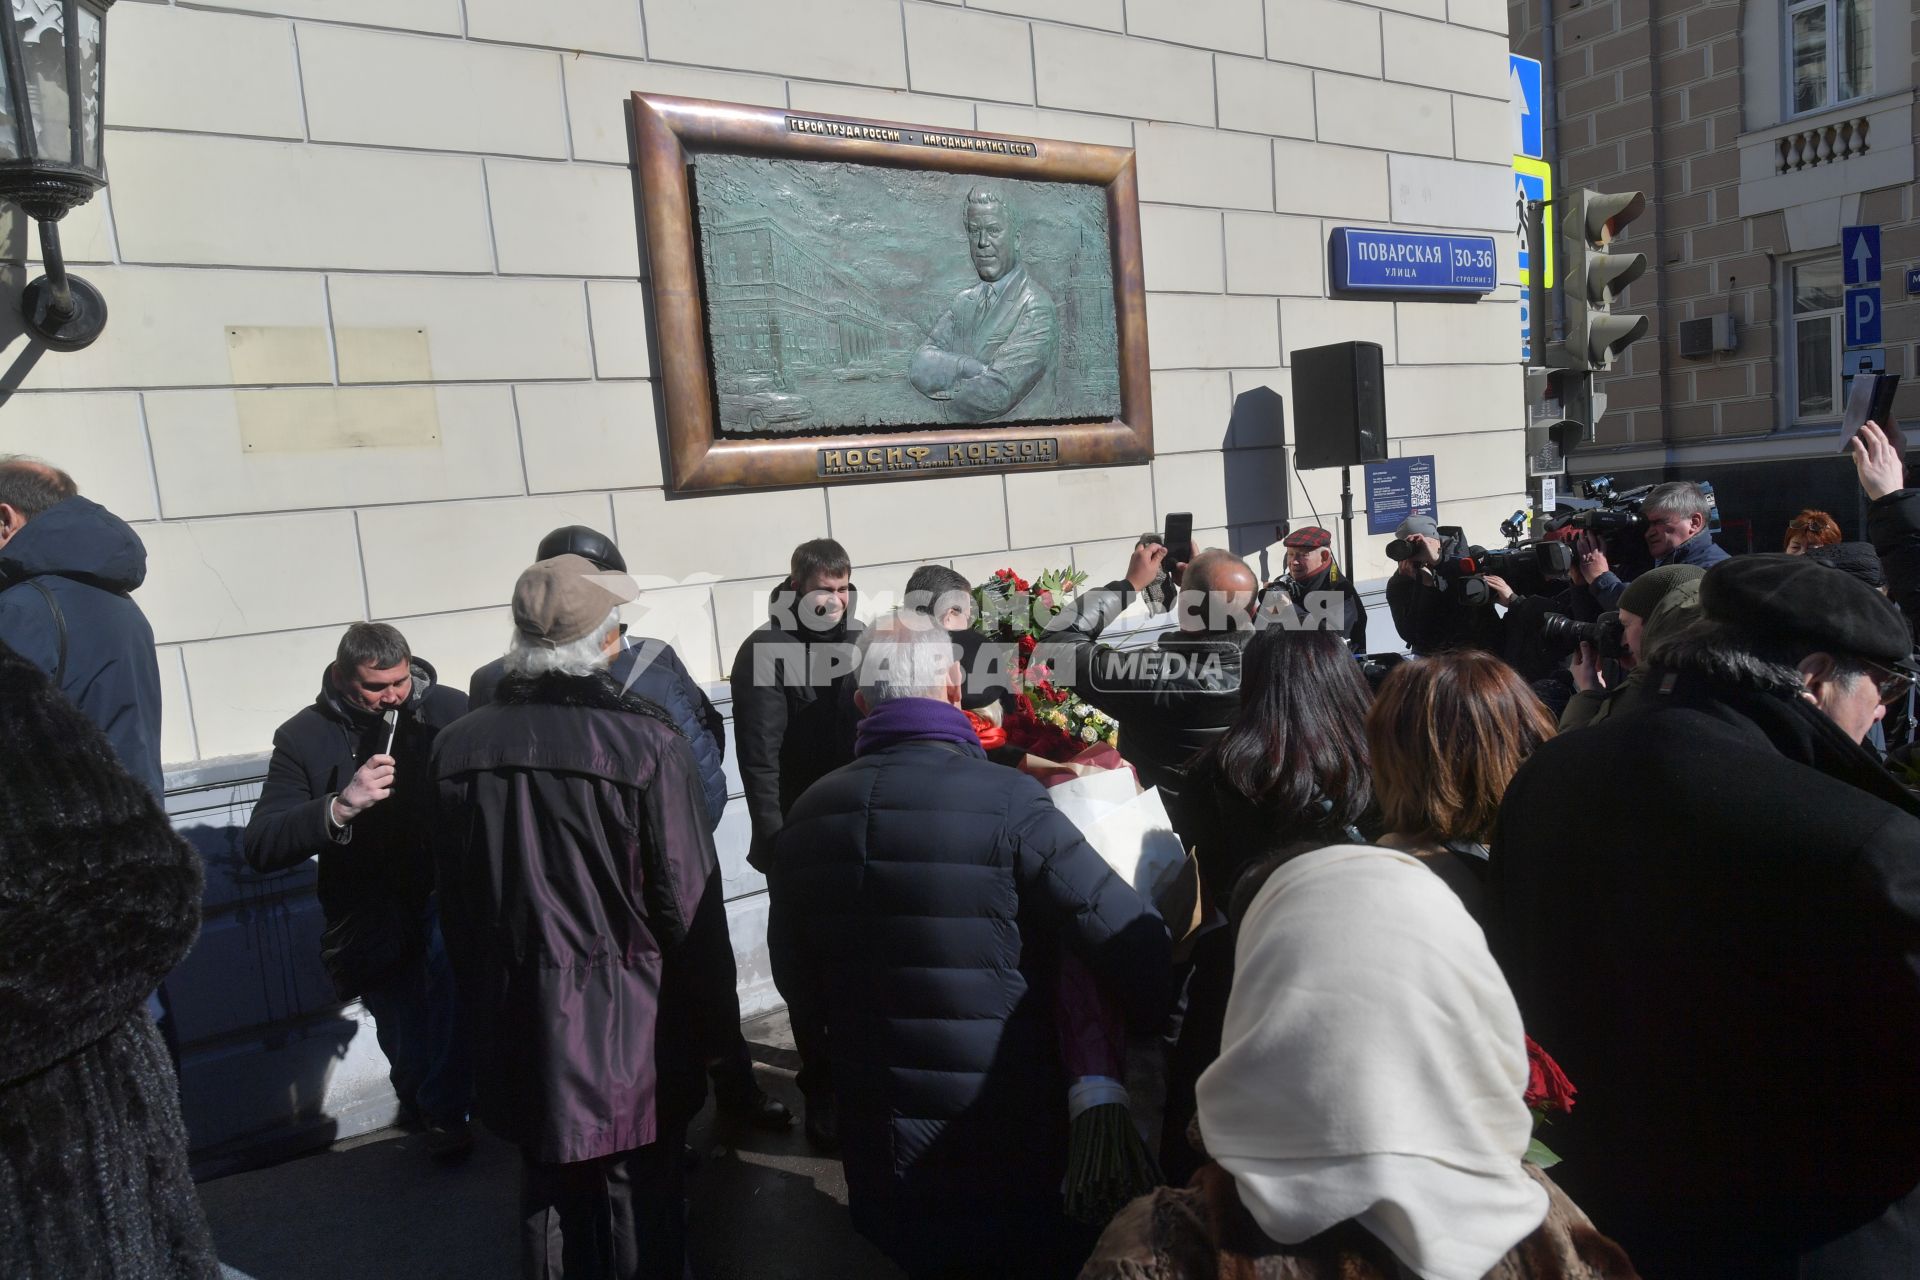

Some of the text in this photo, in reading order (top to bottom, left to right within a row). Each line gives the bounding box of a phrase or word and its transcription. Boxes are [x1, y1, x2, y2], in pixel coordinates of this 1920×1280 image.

[790, 119, 1032, 155] ГЕРОЙ ТРУДА РОССИИ НАРОДНЫЙ АРТИСТ СССР
[1358, 242, 1442, 263] ПОВАРСКАЯ
[1455, 249, 1492, 268] 30-36
[1385, 267, 1417, 278] УЛИЦА
[1455, 275, 1486, 284] СТРОЕНИЕ
[824, 440, 1051, 468] ИОСИФ КОБЗОН
